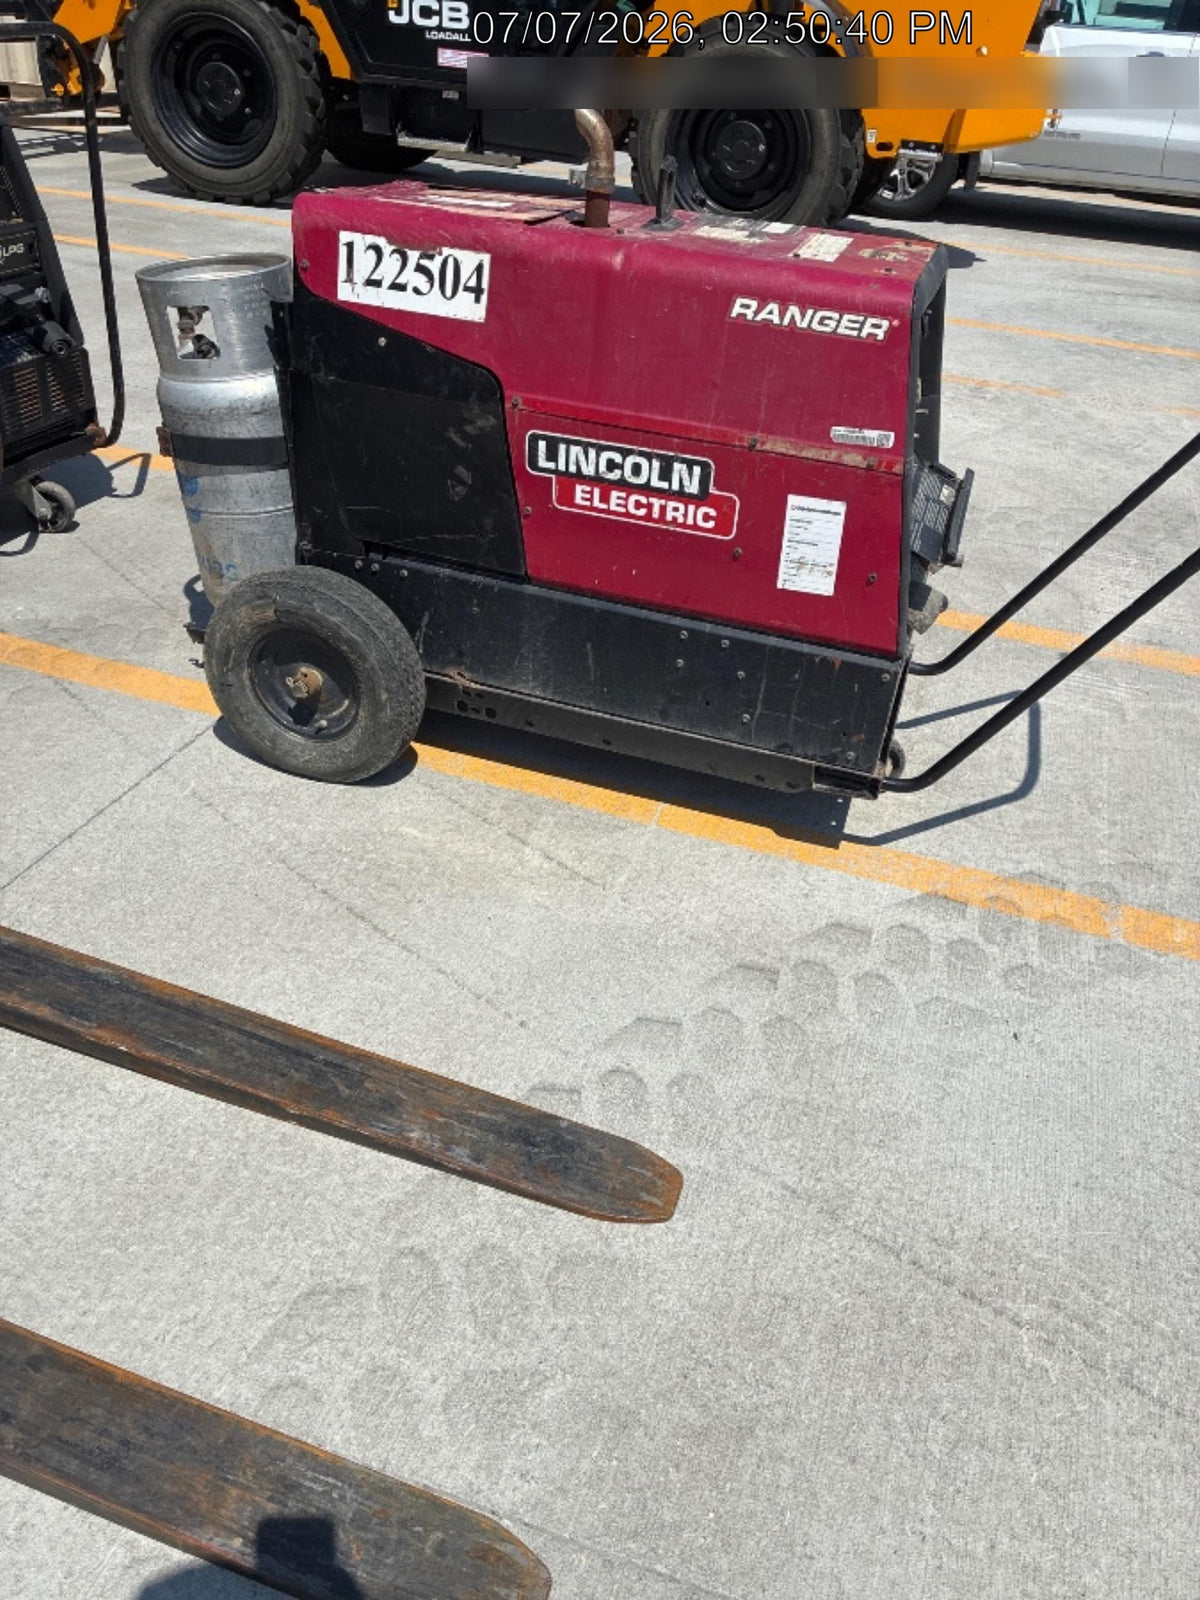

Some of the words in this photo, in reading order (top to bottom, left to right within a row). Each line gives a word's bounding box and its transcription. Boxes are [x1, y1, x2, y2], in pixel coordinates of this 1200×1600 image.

[388, 0, 470, 29] JCB
[425, 30, 472, 42] LOADALL
[340, 240, 486, 304] 122504
[729, 297, 891, 341] RANGER
[537, 439, 702, 496] LINCOLN
[573, 483, 718, 529] ELECTRIC
